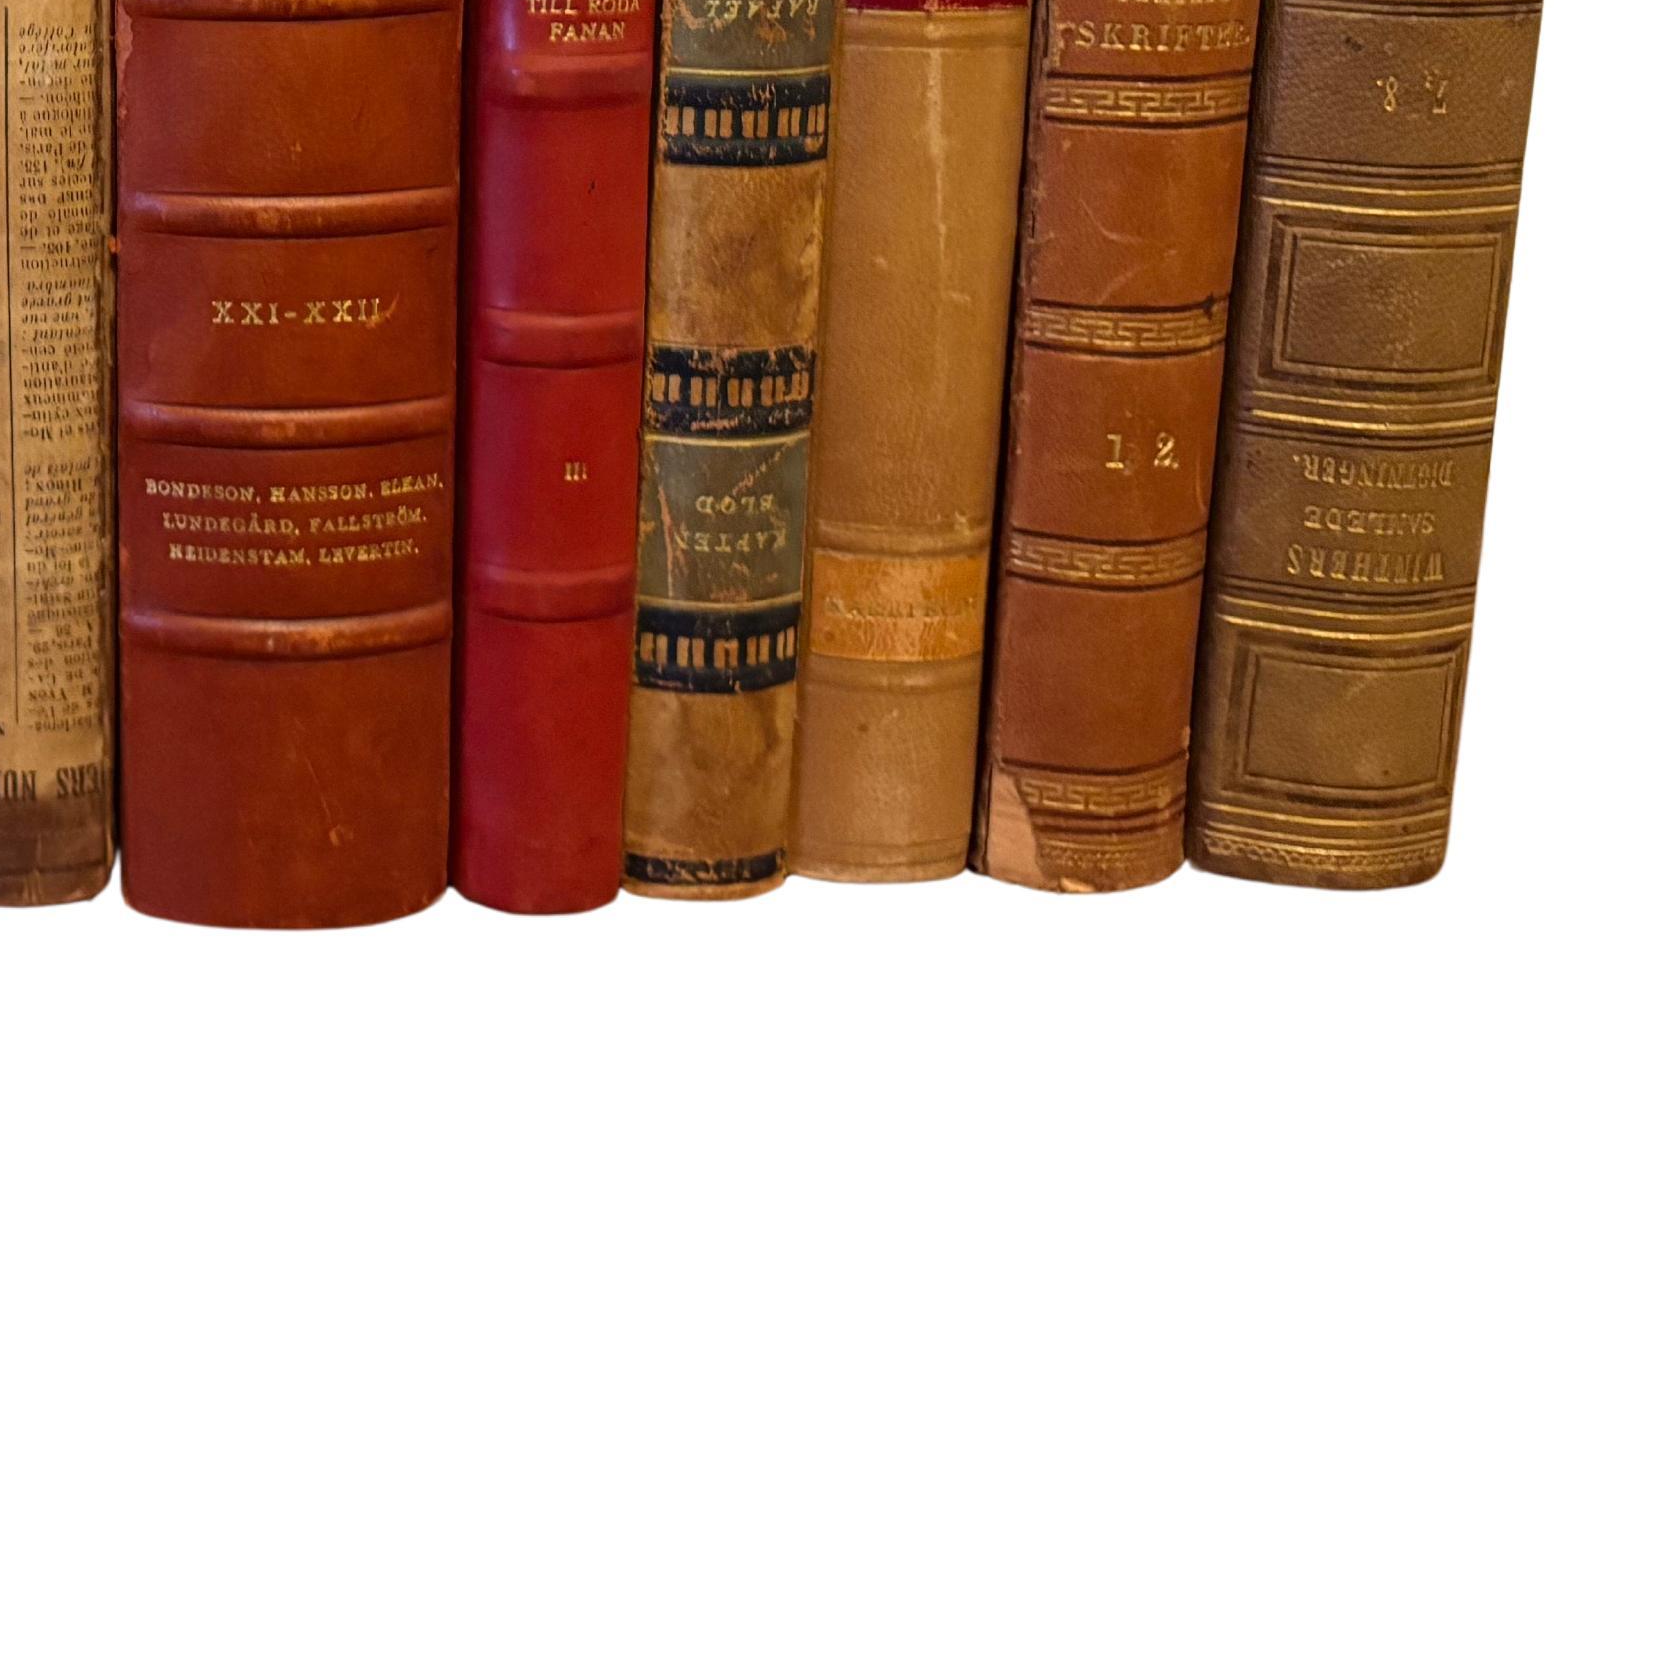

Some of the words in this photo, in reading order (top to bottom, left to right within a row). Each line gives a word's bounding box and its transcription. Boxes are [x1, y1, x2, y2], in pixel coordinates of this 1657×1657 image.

[549, 21, 625, 42] FANAN
[18, 56, 66, 74] mtal,
[144, 477, 262, 504] BONDESON,
[694, 493, 774, 515] BLOD
[1287, 543, 1444, 585] WINTHERS
[55, 762, 107, 801] ERS
